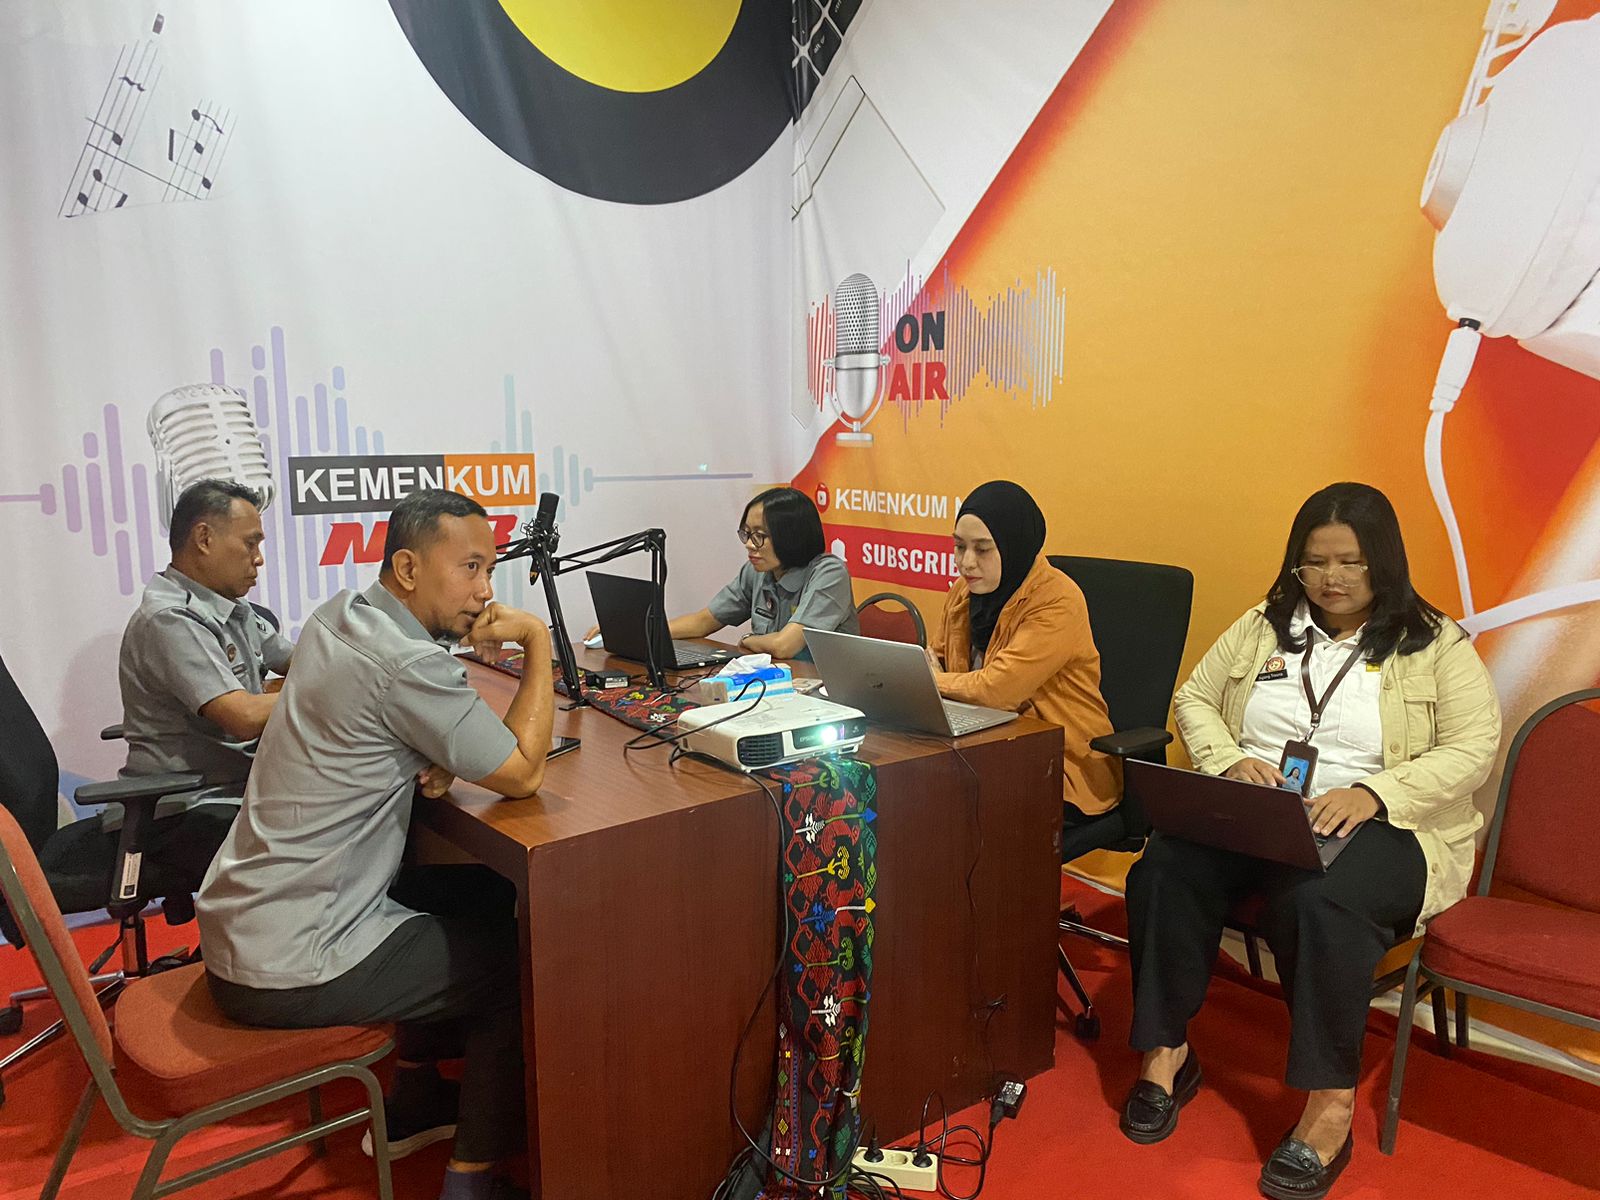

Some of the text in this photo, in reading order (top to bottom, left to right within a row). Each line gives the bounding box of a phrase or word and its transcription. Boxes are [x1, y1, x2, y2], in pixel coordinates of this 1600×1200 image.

[895, 311, 945, 353] ON
[888, 361, 950, 401] AIR
[296, 464, 530, 503] KEMENKUM
[835, 488, 948, 519] KEMENKUM
